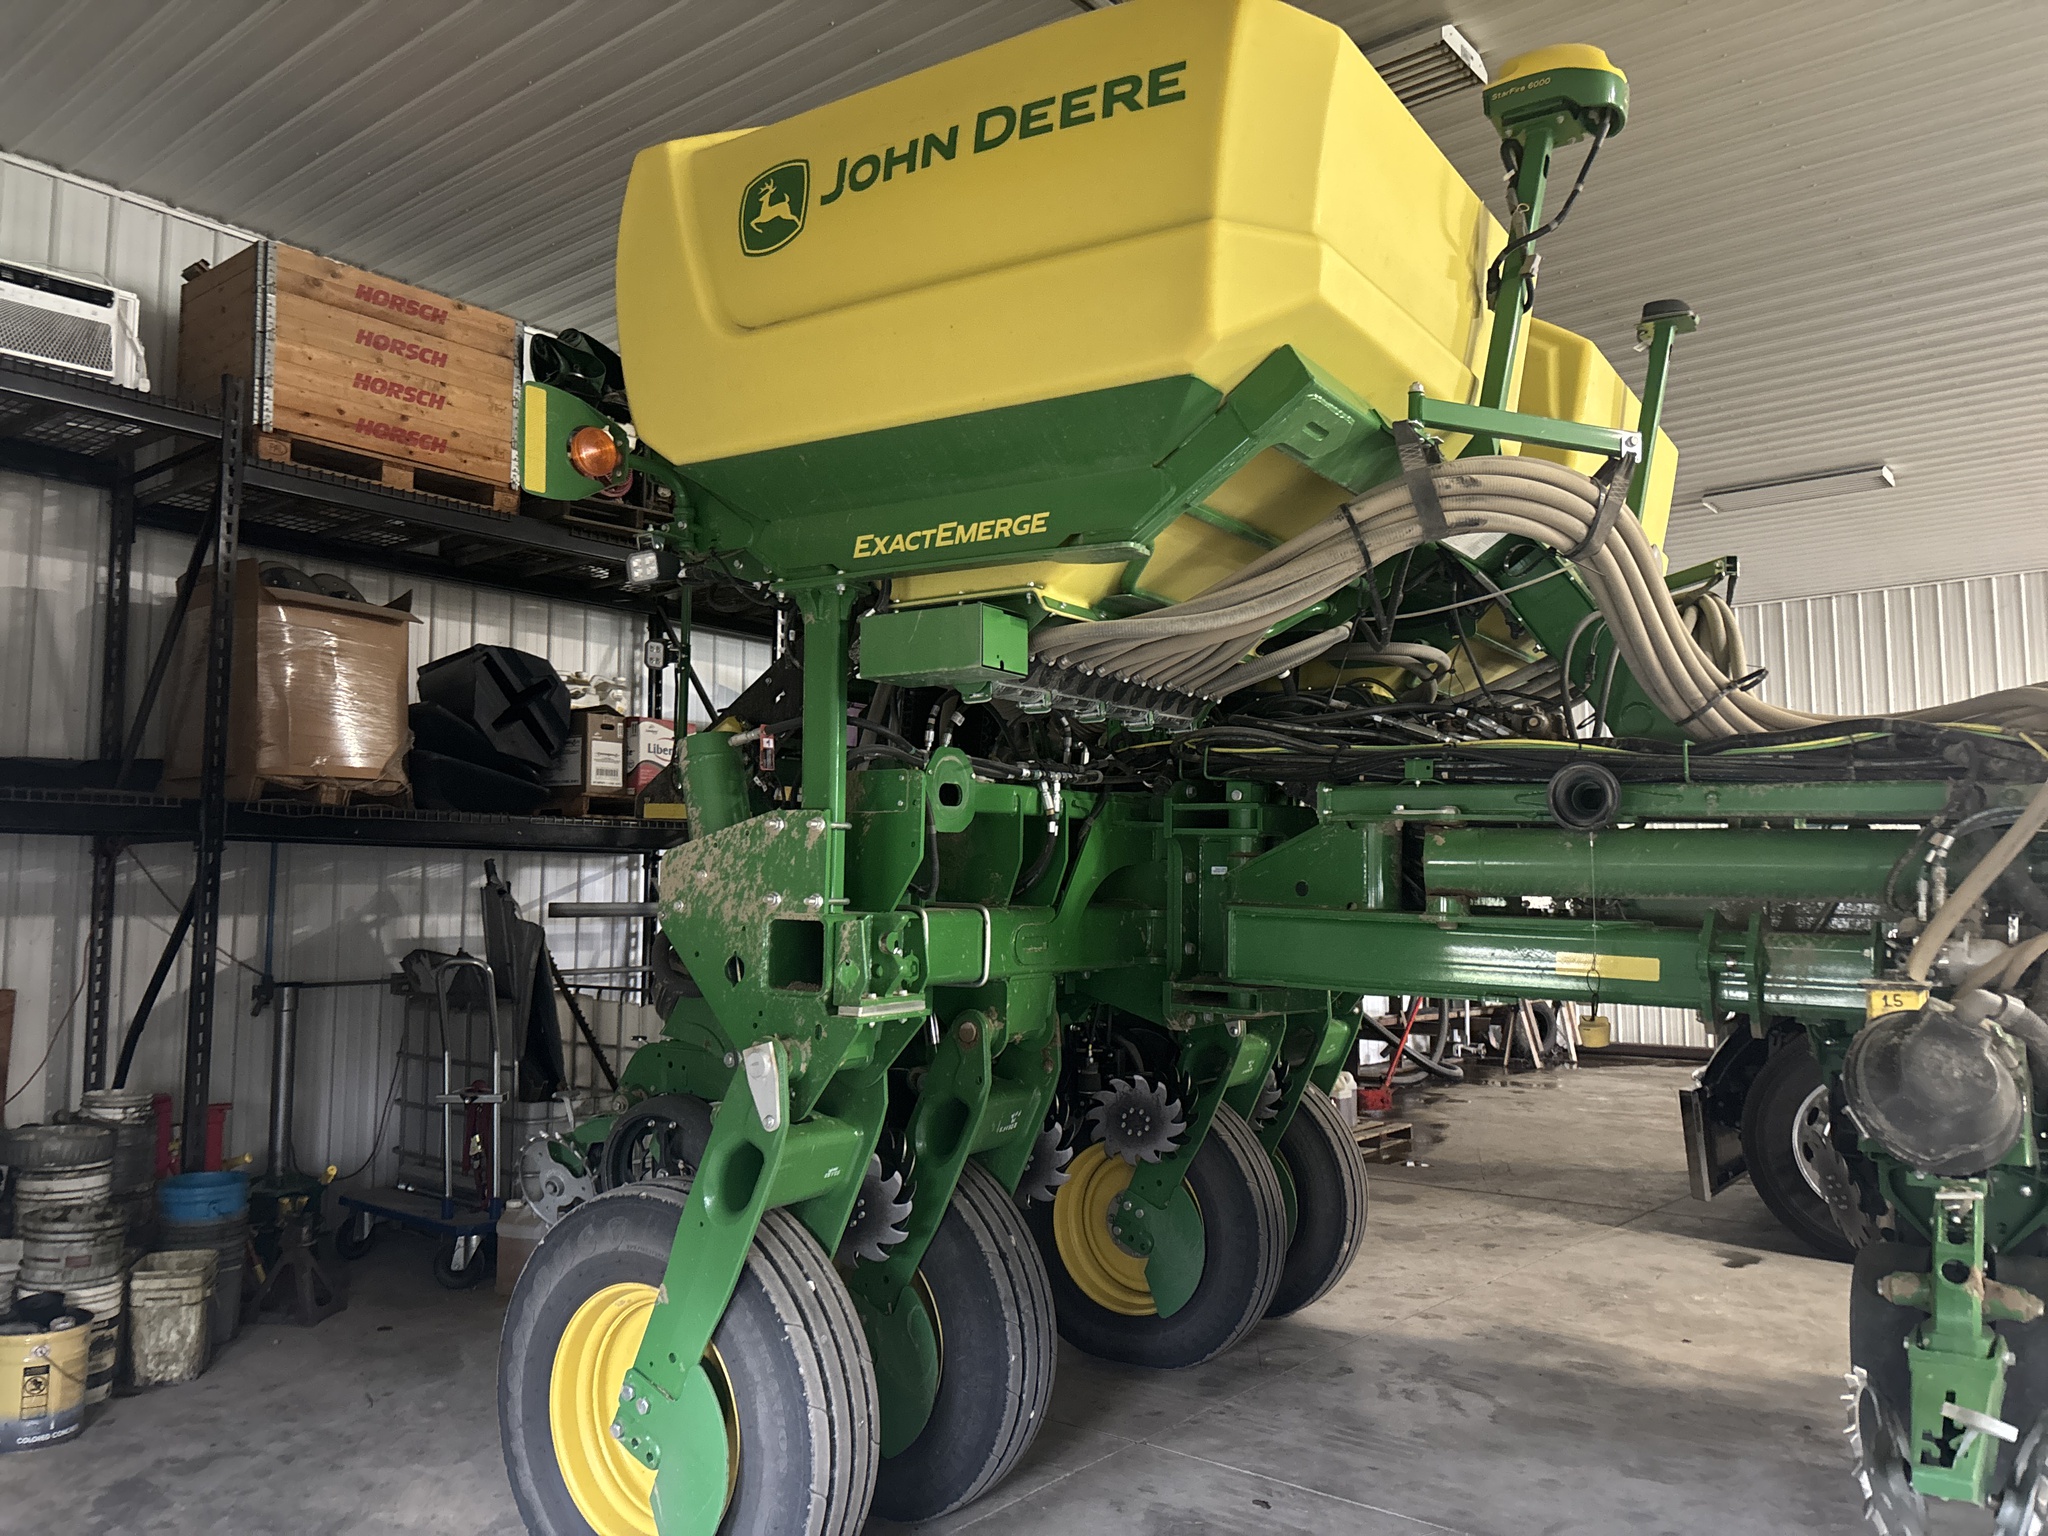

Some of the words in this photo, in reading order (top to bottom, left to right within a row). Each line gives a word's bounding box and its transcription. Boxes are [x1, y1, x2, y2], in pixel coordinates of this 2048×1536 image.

[1491, 85, 1526, 101] StarFire
[1527, 77, 1551, 90] 6000
[820, 124, 959, 206] JOHN
[973, 60, 1187, 154] DEERE
[354, 284, 449, 325] HORSCH
[355, 329, 448, 368] HORSCH
[352, 372, 446, 410] HORSCH
[355, 418, 448, 454] HORSCH
[1882, 993, 1904, 1008] 15
